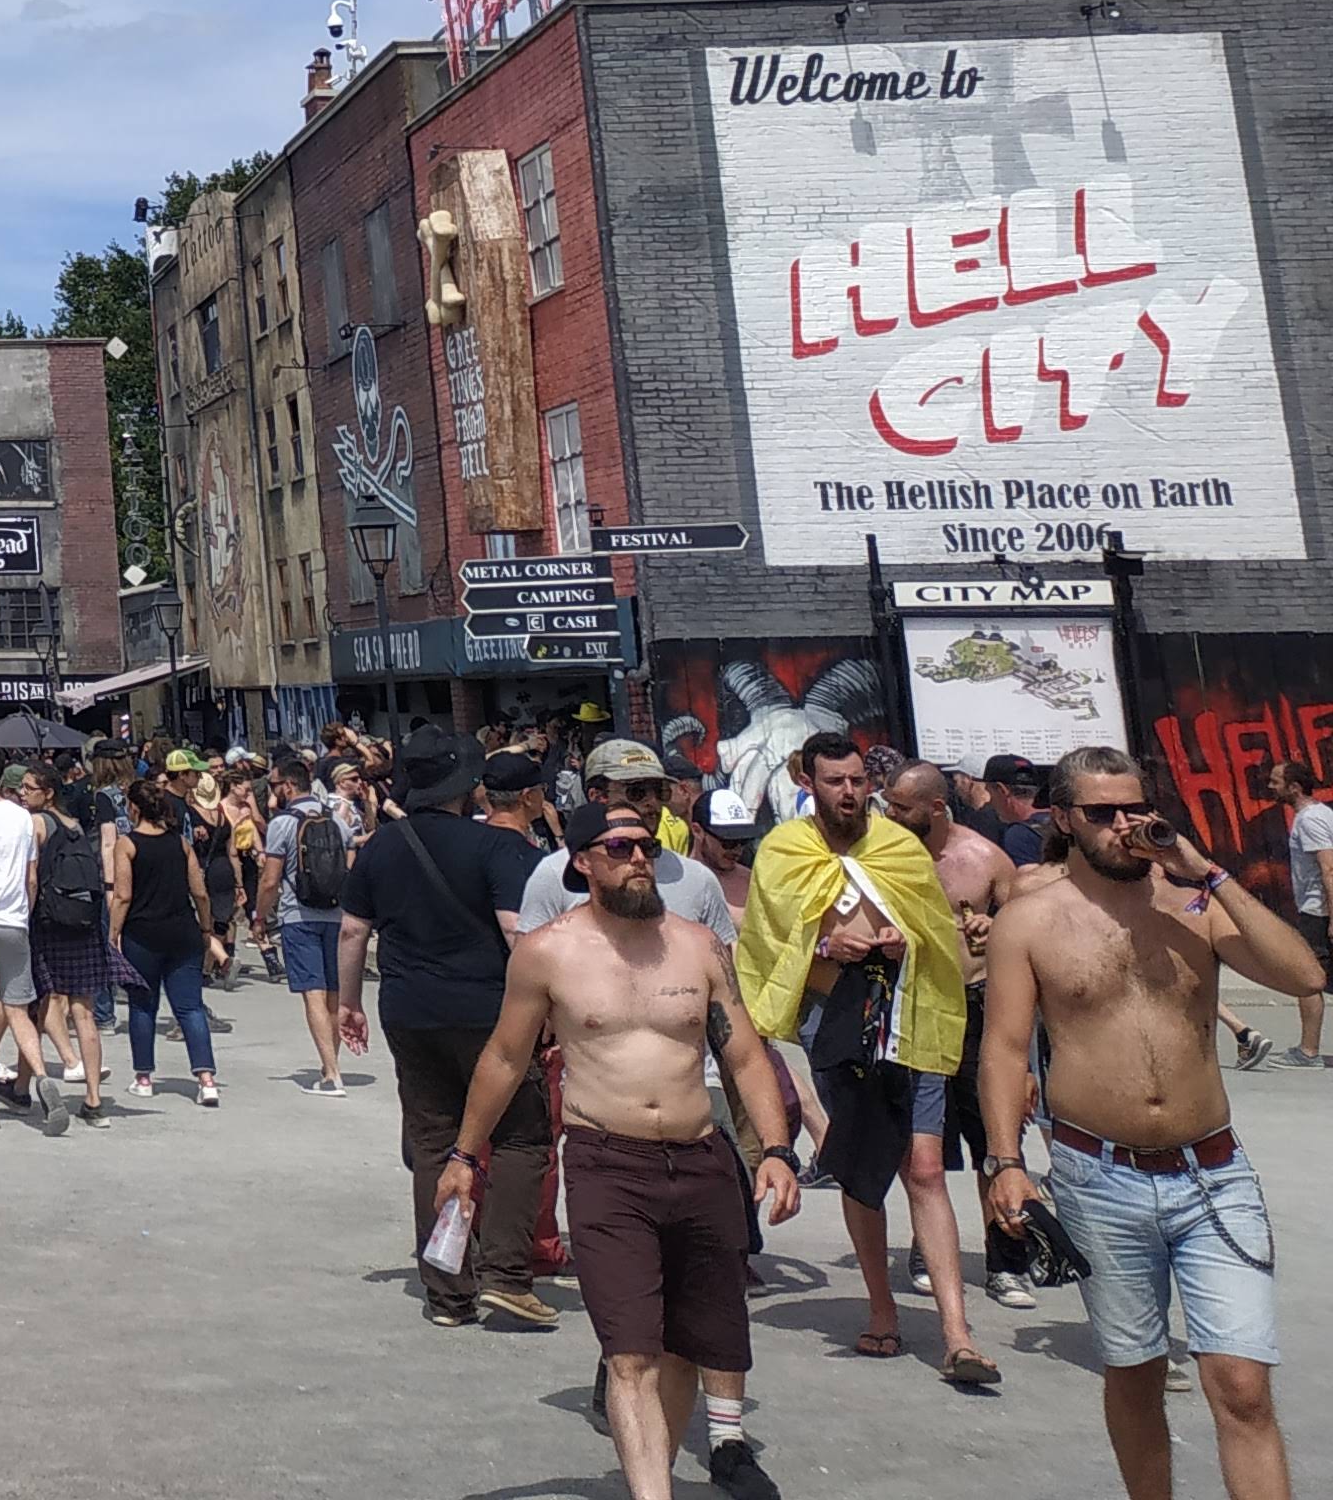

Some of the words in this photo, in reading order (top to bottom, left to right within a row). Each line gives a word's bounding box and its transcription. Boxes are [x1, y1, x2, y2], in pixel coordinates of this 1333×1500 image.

[729, 53, 931, 106] Welcome
[939, 49, 984, 100] to
[789, 174, 1163, 359] HELL
[868, 274, 1248, 457] CITY
[460, 441, 490, 480] HELL
[814, 479, 875, 511] The
[884, 478, 993, 511] Hellish
[1003, 478, 1090, 509] Place
[1101, 484, 1143, 508] on
[1151, 476, 1233, 507] Earth
[610, 531, 692, 547] FESTIVAL
[942, 523, 1025, 553] Since
[464, 565, 522, 579] METAL
[524, 562, 593, 578] CORNER
[516, 589, 595, 604] CAMPING
[915, 585, 997, 602] CITY
[1011, 584, 1092, 601] MAP
[552, 614, 598, 630] CASH
[353, 636, 373, 672] SEA
[373, 629, 421, 671] SHPHERD
